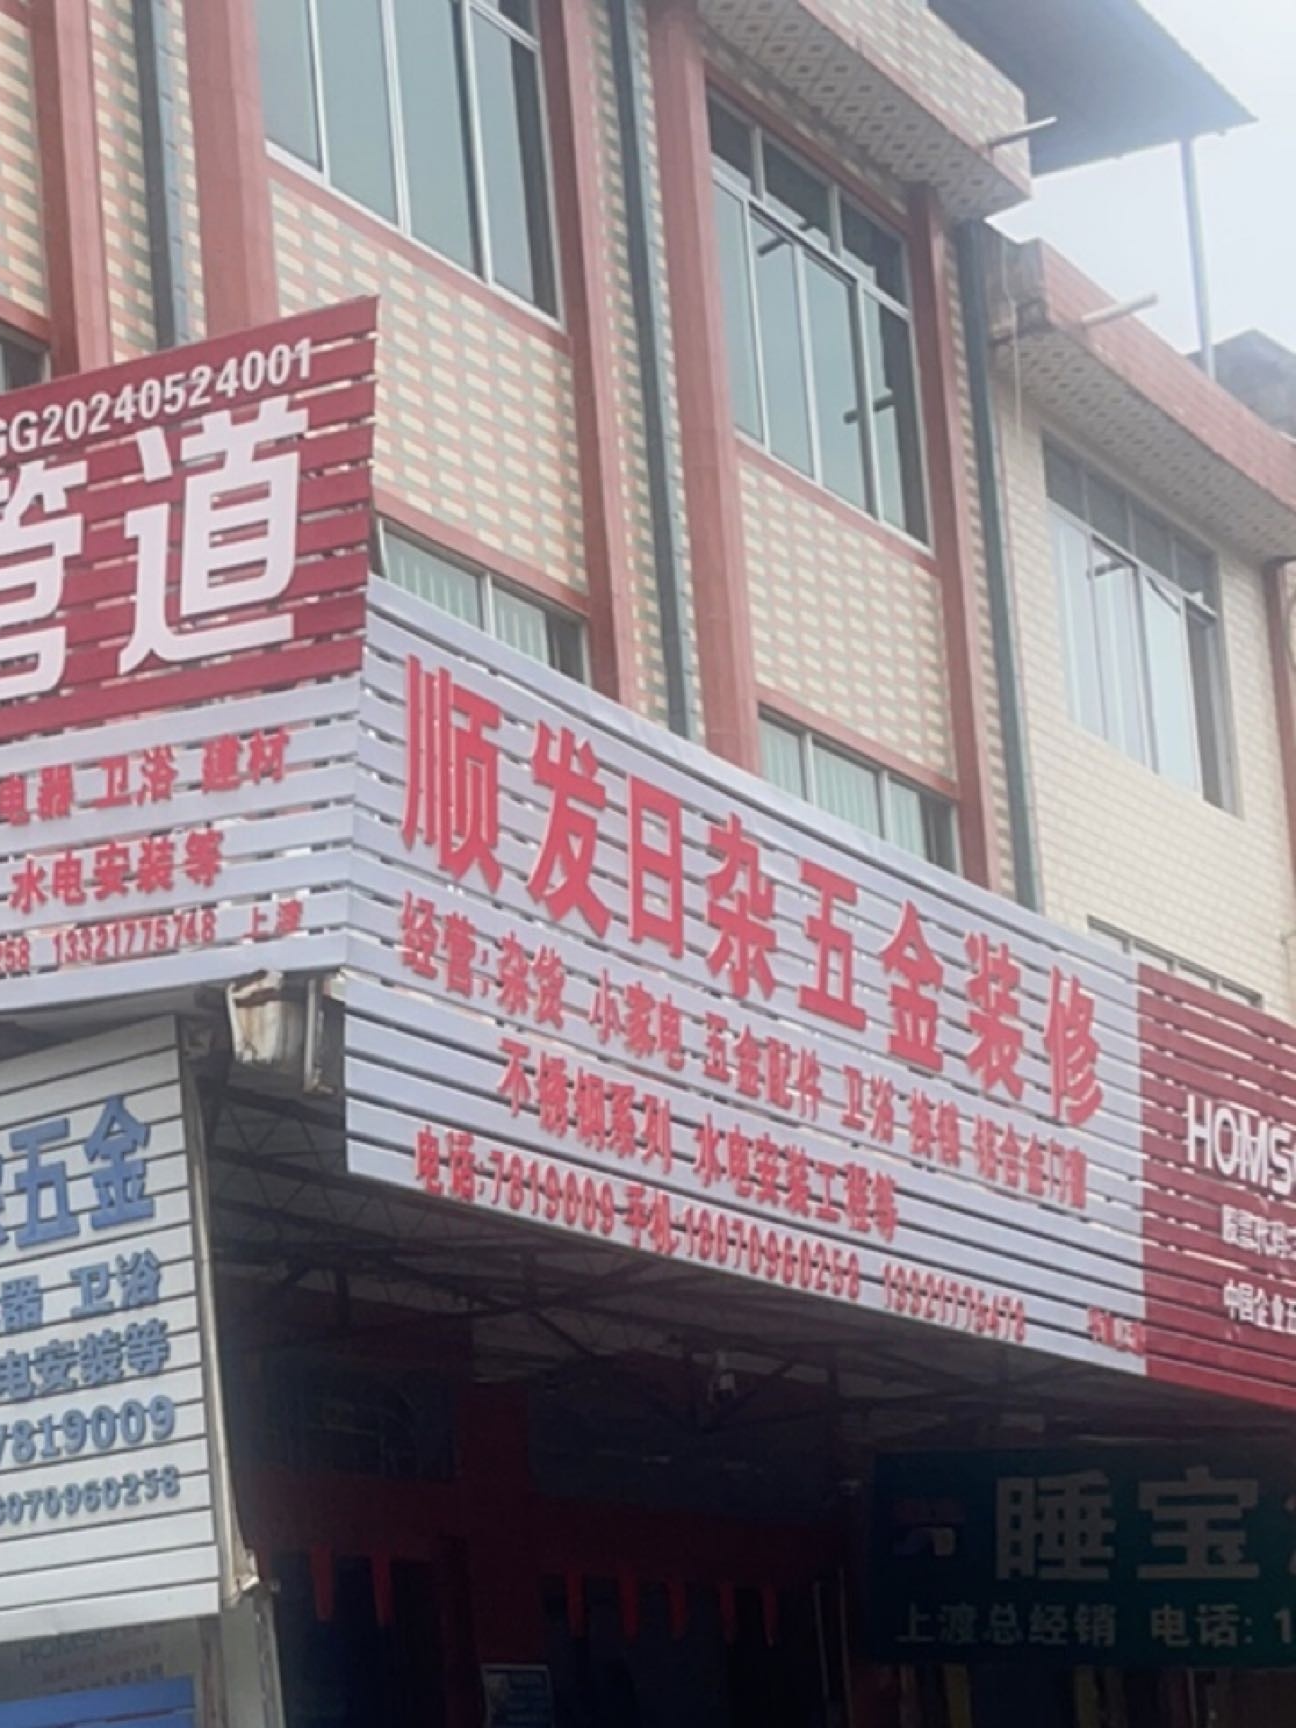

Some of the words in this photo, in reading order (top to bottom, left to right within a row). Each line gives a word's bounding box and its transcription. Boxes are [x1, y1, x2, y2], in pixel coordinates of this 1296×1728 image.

[92, 743, 178, 808] 卫浴
[10, 828, 224, 914] 水电安装等
[401, 654, 1103, 1126] 顺发日杂五金装修
[1186, 1093, 1296, 1196] HOMS
[70, 1249, 162, 1318] 卫浴
[996, 1466, 1296, 1580] 睡宝
